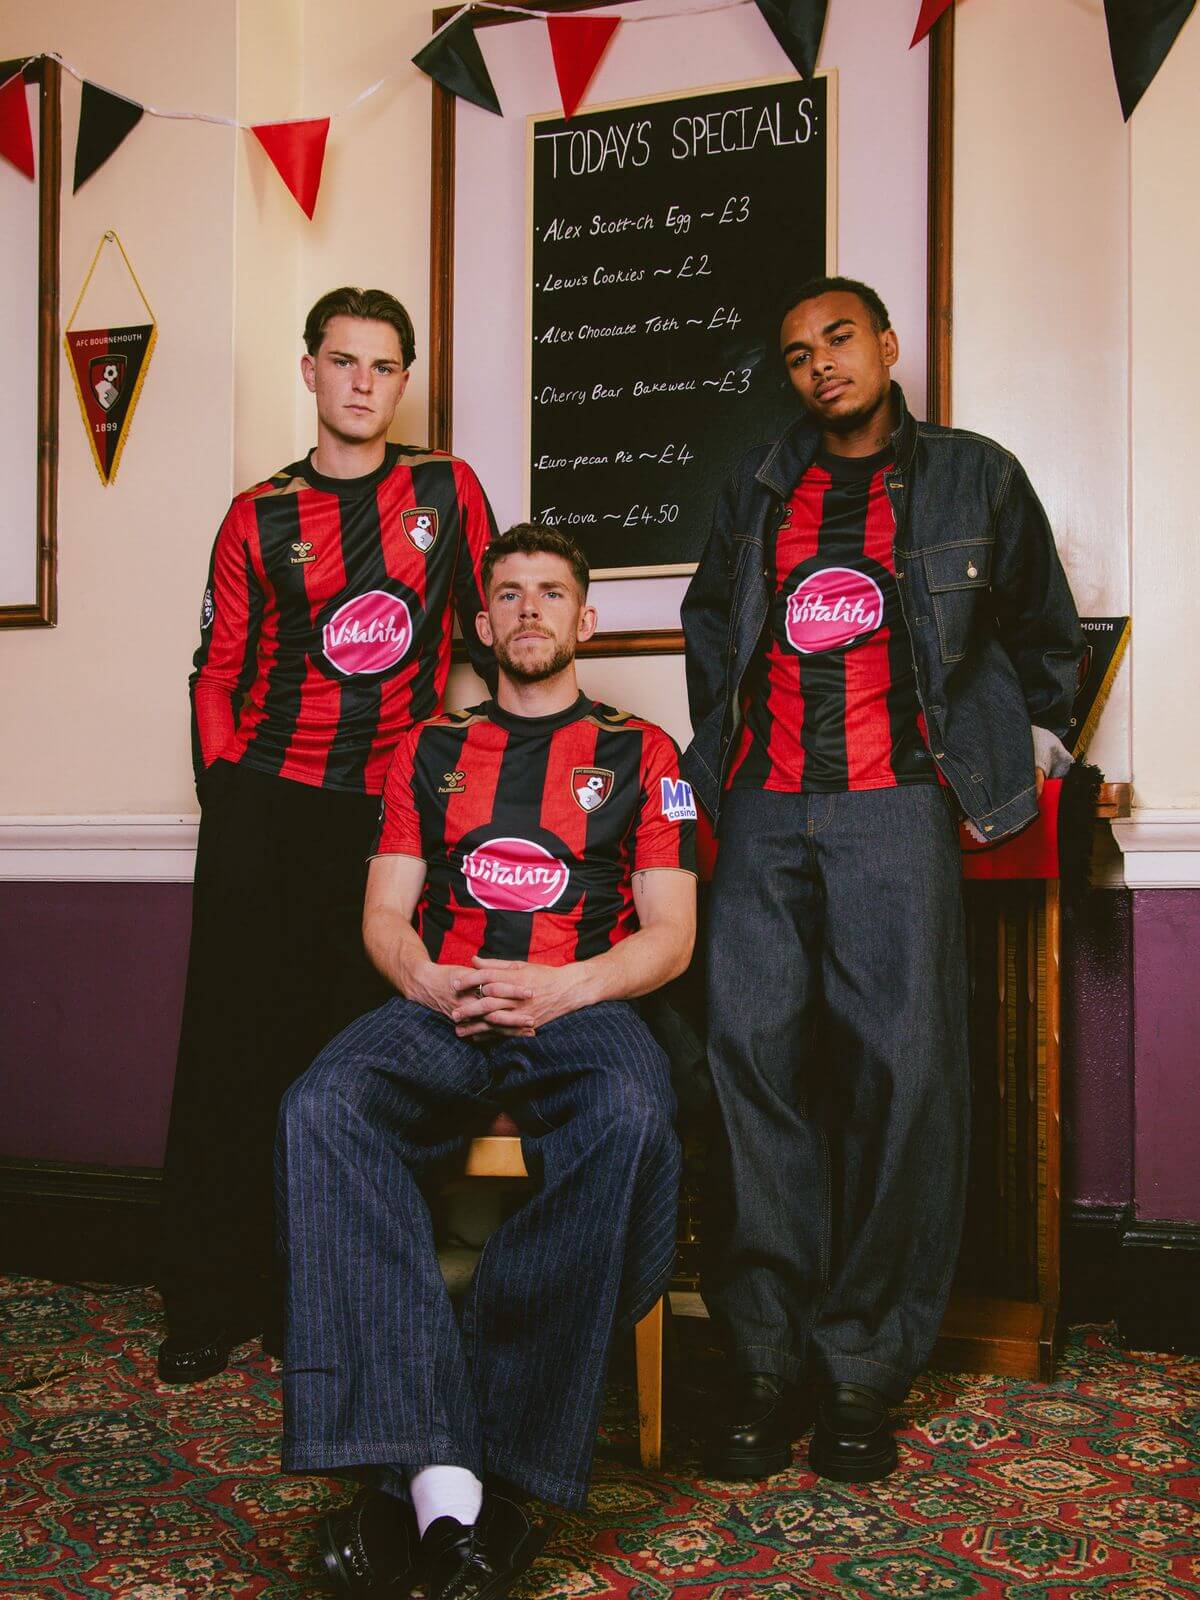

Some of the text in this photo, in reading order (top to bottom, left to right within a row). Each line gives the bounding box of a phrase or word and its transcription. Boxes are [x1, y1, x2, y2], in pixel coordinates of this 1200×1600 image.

[535, 97, 819, 179] TODAY'S SPECIALS:
[543, 218, 583, 243] Alex
[589, 214, 655, 236] Scott-ch
[665, 205, 692, 235] Egg
[592, 266, 646, 286] Cookies
[76, 334, 143, 348] AFC BOURNEMOUTH
[539, 326, 574, 344] Alex
[577, 323, 637, 340] Chocolate
[540, 386, 587, 405] Cherry
[591, 384, 624, 401] Bear
[632, 380, 696, 397] Bakewell
[95, 422, 118, 433] 1899
[537, 454, 609, 470] Euro-pecan
[614, 450, 634, 464] Pie
[540, 506, 598, 527] Tav-lova
[792, 593, 875, 633] Vitality
[330, 615, 406, 651] Vitality
[1080, 623, 1114, 631] MOUTH
[669, 807, 696, 818] casino
[468, 857, 561, 895] Vitality
